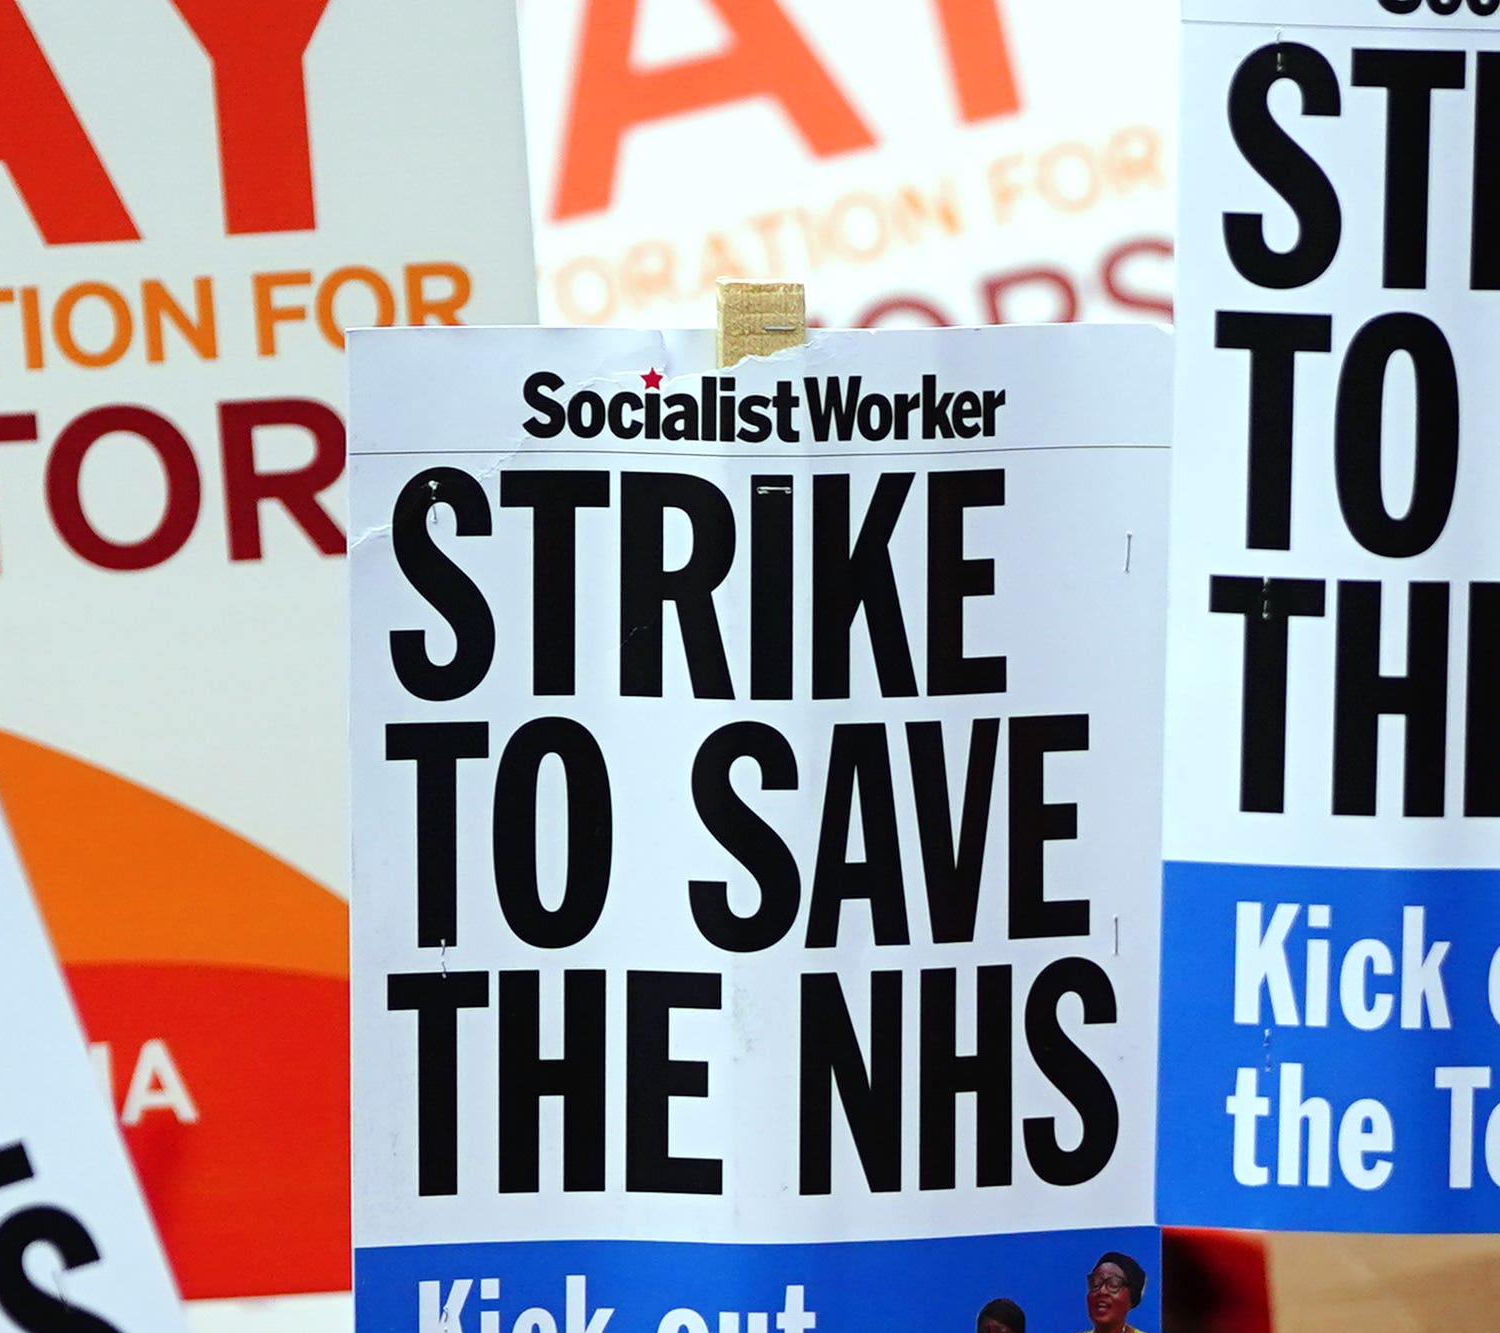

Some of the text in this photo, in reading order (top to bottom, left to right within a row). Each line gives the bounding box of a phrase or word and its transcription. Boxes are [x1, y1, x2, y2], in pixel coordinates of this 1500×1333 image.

[253, 262, 472, 356] FOR
[522, 371, 1006, 443] Socialist Worker
[1215, 311, 1460, 559] TO
[389, 466, 1007, 702] STRIKE
[384, 713, 1089, 953] TO SAVE
[1235, 900, 1452, 1030] Kick
[387, 956, 1119, 1197] THE NHS
[1226, 1060, 1395, 1193] the
